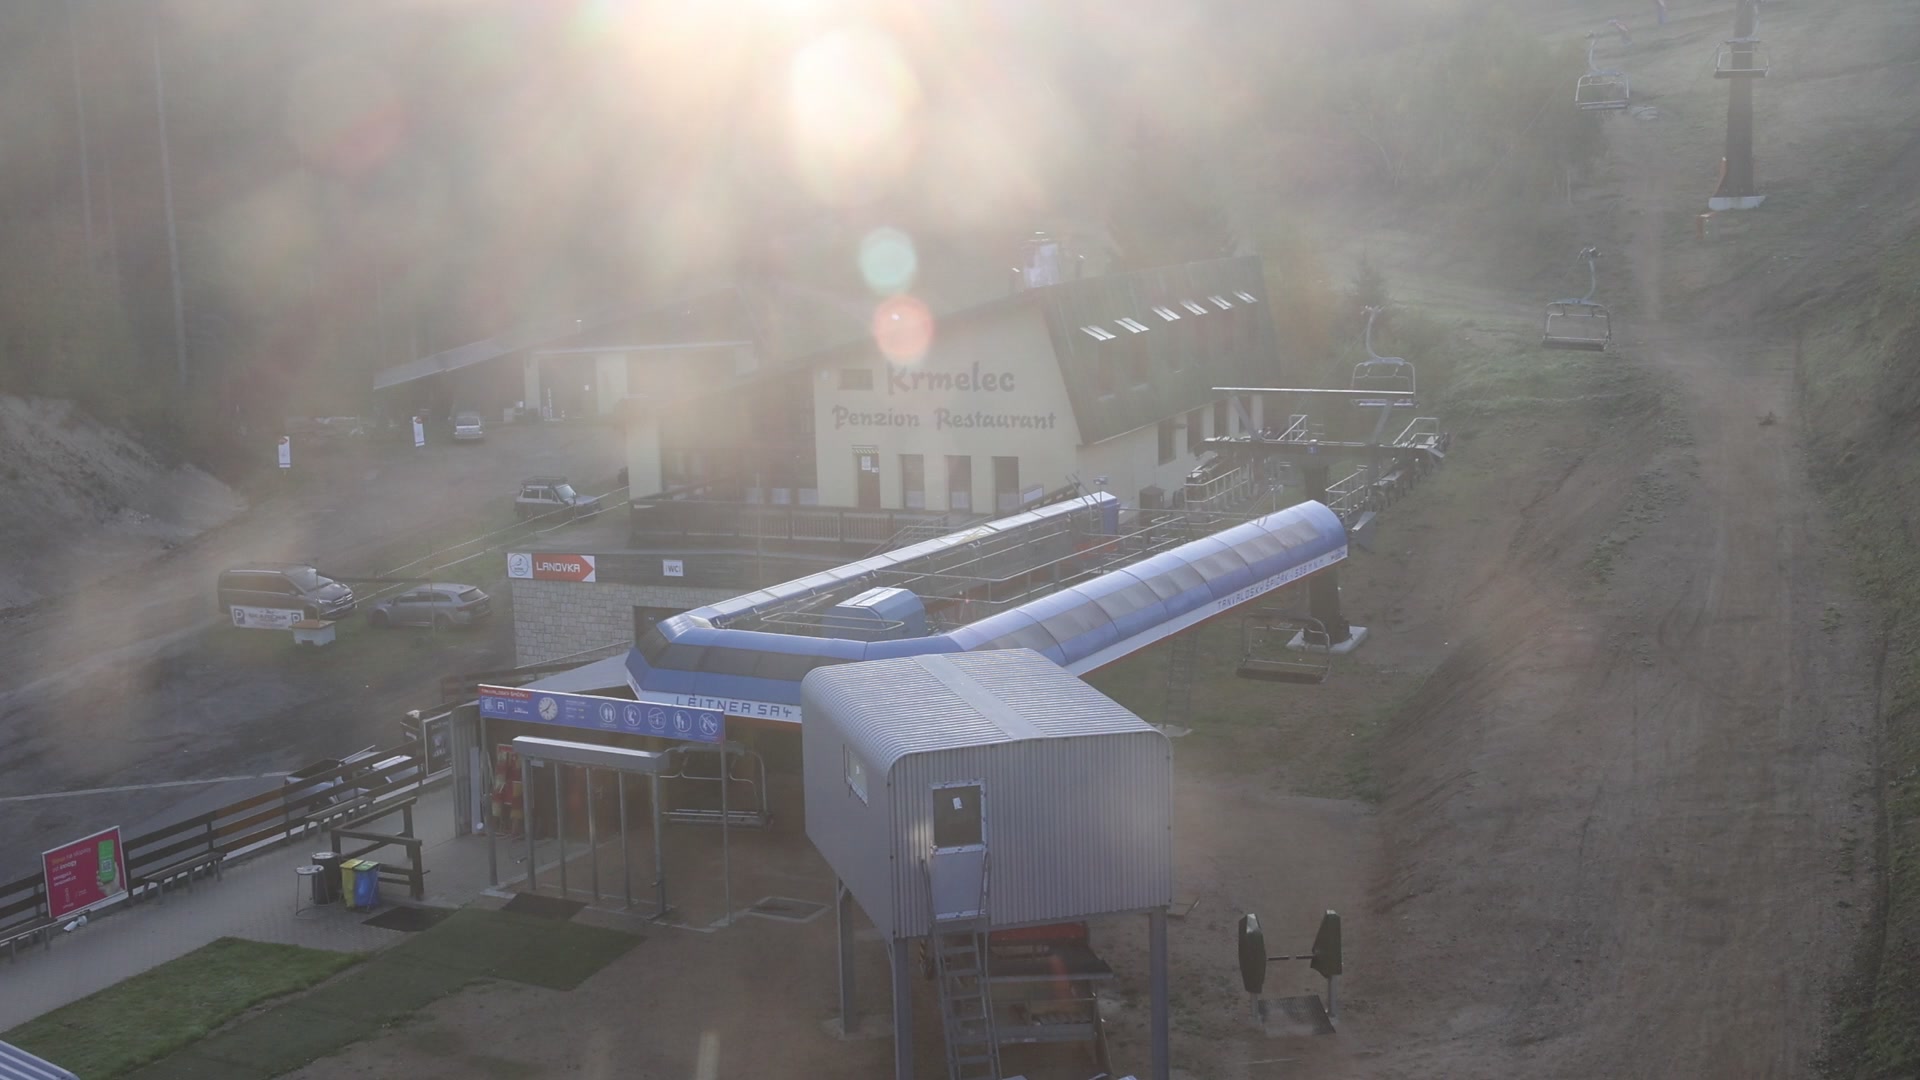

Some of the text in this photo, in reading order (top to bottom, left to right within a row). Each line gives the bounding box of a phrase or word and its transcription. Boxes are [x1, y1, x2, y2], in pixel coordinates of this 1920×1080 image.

[887, 360, 1016, 395] Krmelec
[831, 404, 1057, 431] Penzion Restaurant
[536, 561, 581, 573] LANOVKA
